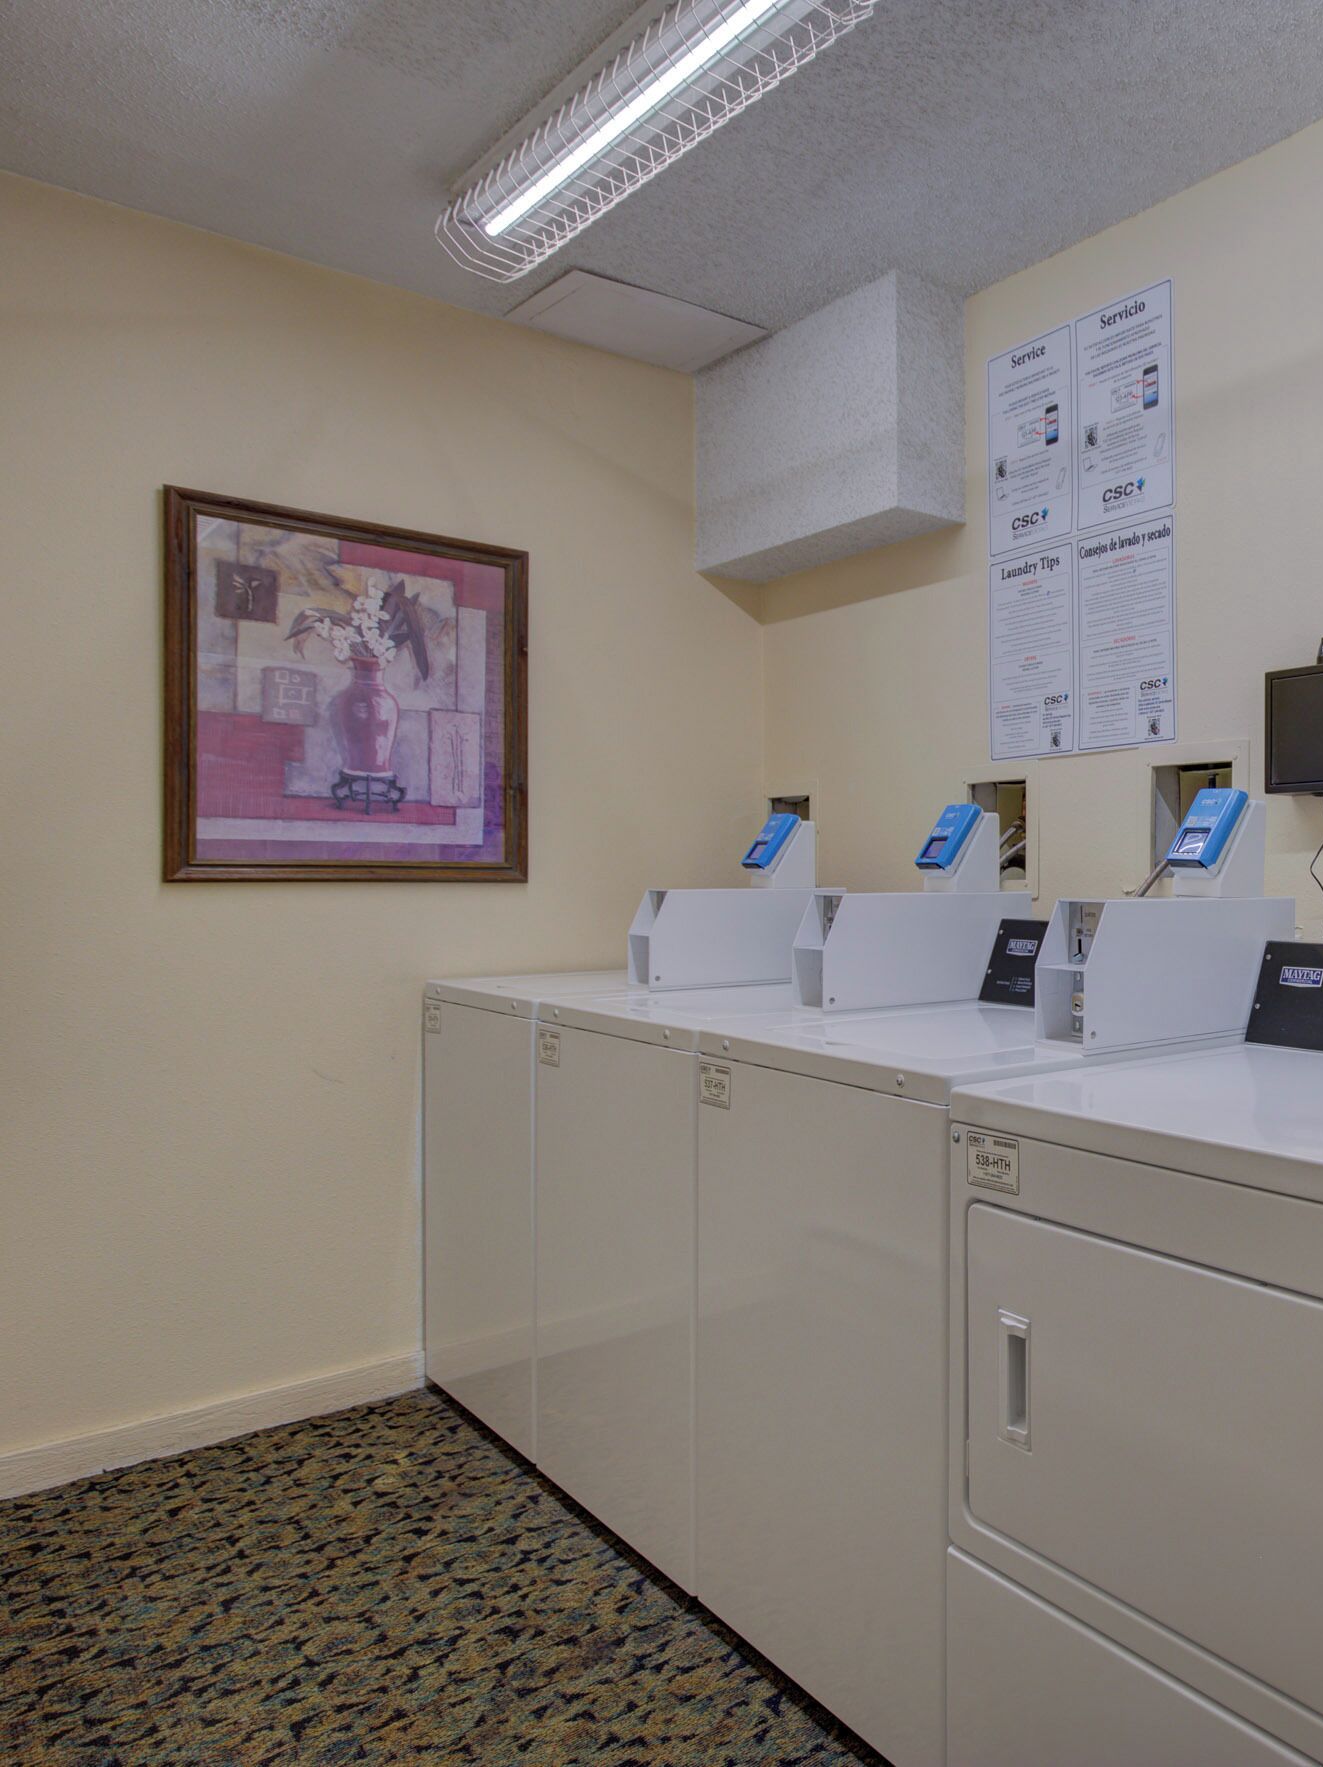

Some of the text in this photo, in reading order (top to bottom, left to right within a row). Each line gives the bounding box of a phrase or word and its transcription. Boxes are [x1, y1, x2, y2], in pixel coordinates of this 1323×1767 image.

[1100, 300, 1146, 330] Servicio
[1011, 344, 1046, 369] Service
[1102, 482, 1134, 503] CSC
[1011, 511, 1039, 531] CSC
[1079, 541, 1108, 560] Consejos
[1109, 538, 1117, 552] de
[1118, 532, 1140, 550] lavado
[1141, 533, 1146, 547] y
[1147, 523, 1171, 541] secado
[1001, 556, 1060, 581] Laundry Tips
[1139, 679, 1162, 691] CSC
[1043, 695, 1063, 706] CSC
[1283, 969, 1321, 980] MAYTAG
[969, 1136, 981, 1144] CSC
[975, 1154, 1011, 1172] 538-HTH
